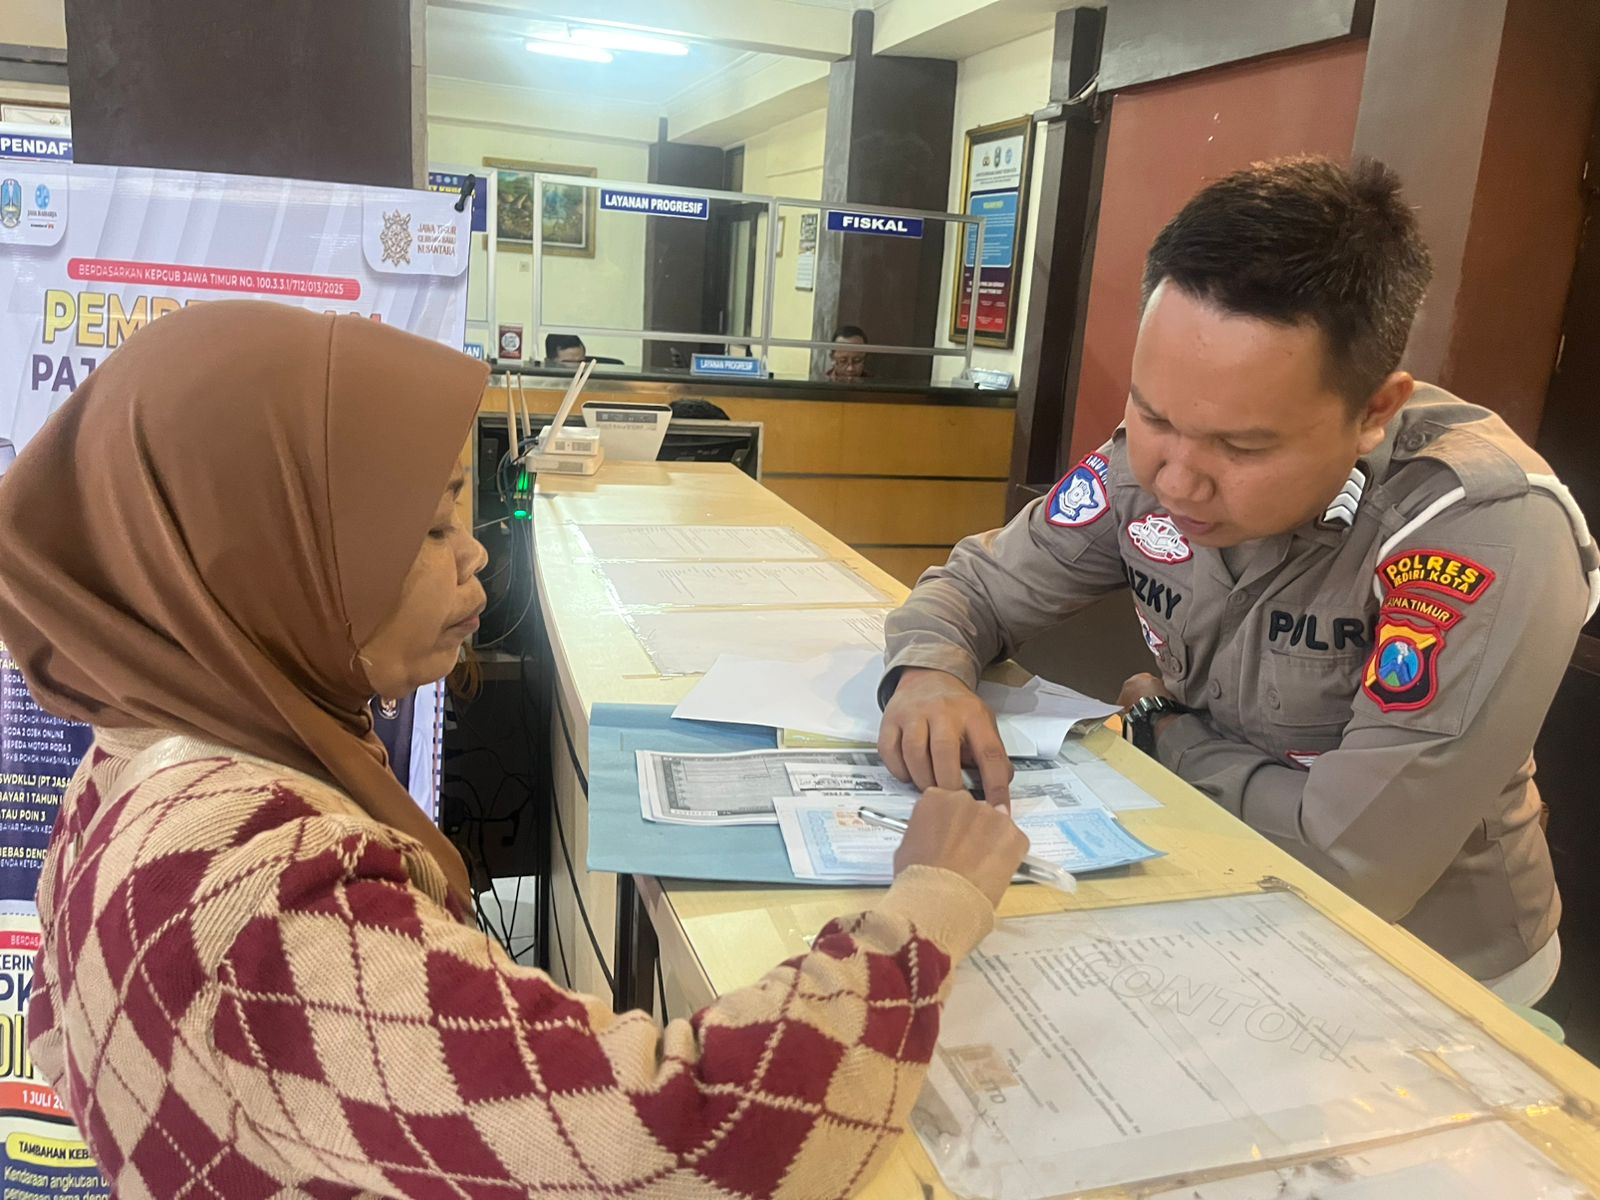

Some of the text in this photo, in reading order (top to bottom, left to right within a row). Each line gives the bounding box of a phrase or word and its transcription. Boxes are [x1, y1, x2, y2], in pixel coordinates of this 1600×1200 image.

[0, 137, 72, 155] PENDAF
[605, 194, 703, 214] LAYANAN PROGRESIF
[842, 215, 908, 232] FISKAL
[79, 264, 143, 279] BERDASARKAN
[182, 271, 208, 284] JAWA
[209, 273, 238, 288] TIMUR
[464, 346, 480, 358] AN
[1386, 554, 1480, 584] POLRES
[1429, 570, 1470, 594] KOTA
[1410, 599, 1451, 622] TIMUR
[31, 793, 58, 805] TAHUN
[0, 809, 18, 820] TAU
[20, 810, 39, 821] POIN
[0, 846, 48, 860] EBAS DEND
[0, 954, 35, 971] ERIN
[1070, 950, 1357, 1063] CONTOH
[29, 1090, 51, 1107] JULI
[19, 1140, 67, 1160] TAMBAHAN
[50, 1173, 99, 1192] angkutan
